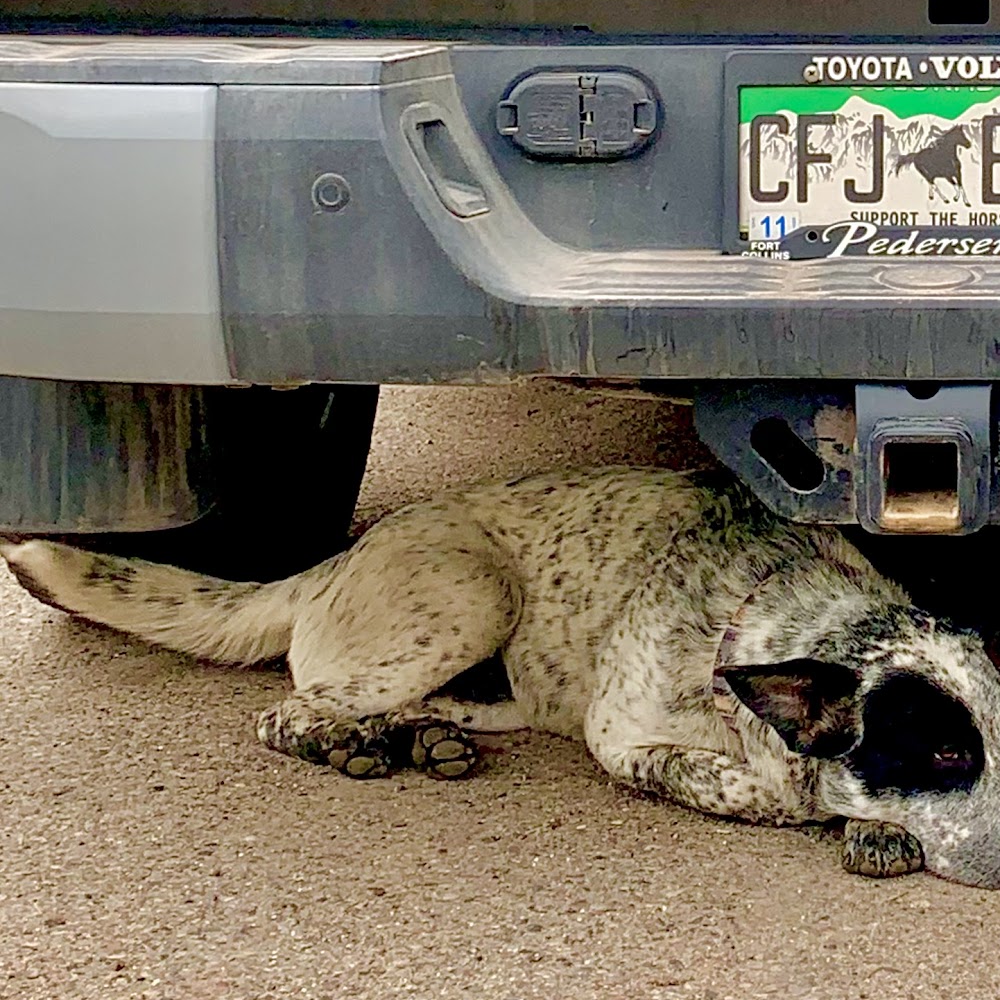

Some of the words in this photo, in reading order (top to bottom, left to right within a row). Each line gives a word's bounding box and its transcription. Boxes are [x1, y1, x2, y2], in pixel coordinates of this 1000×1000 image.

[812, 56, 914, 81] TOYOTA
[749, 114, 884, 204] CFJ
[760, 215, 786, 239] 11
[850, 211, 919, 226] SUPPORT
[929, 212, 958, 226] THE
[751, 241, 781, 251] FORT
